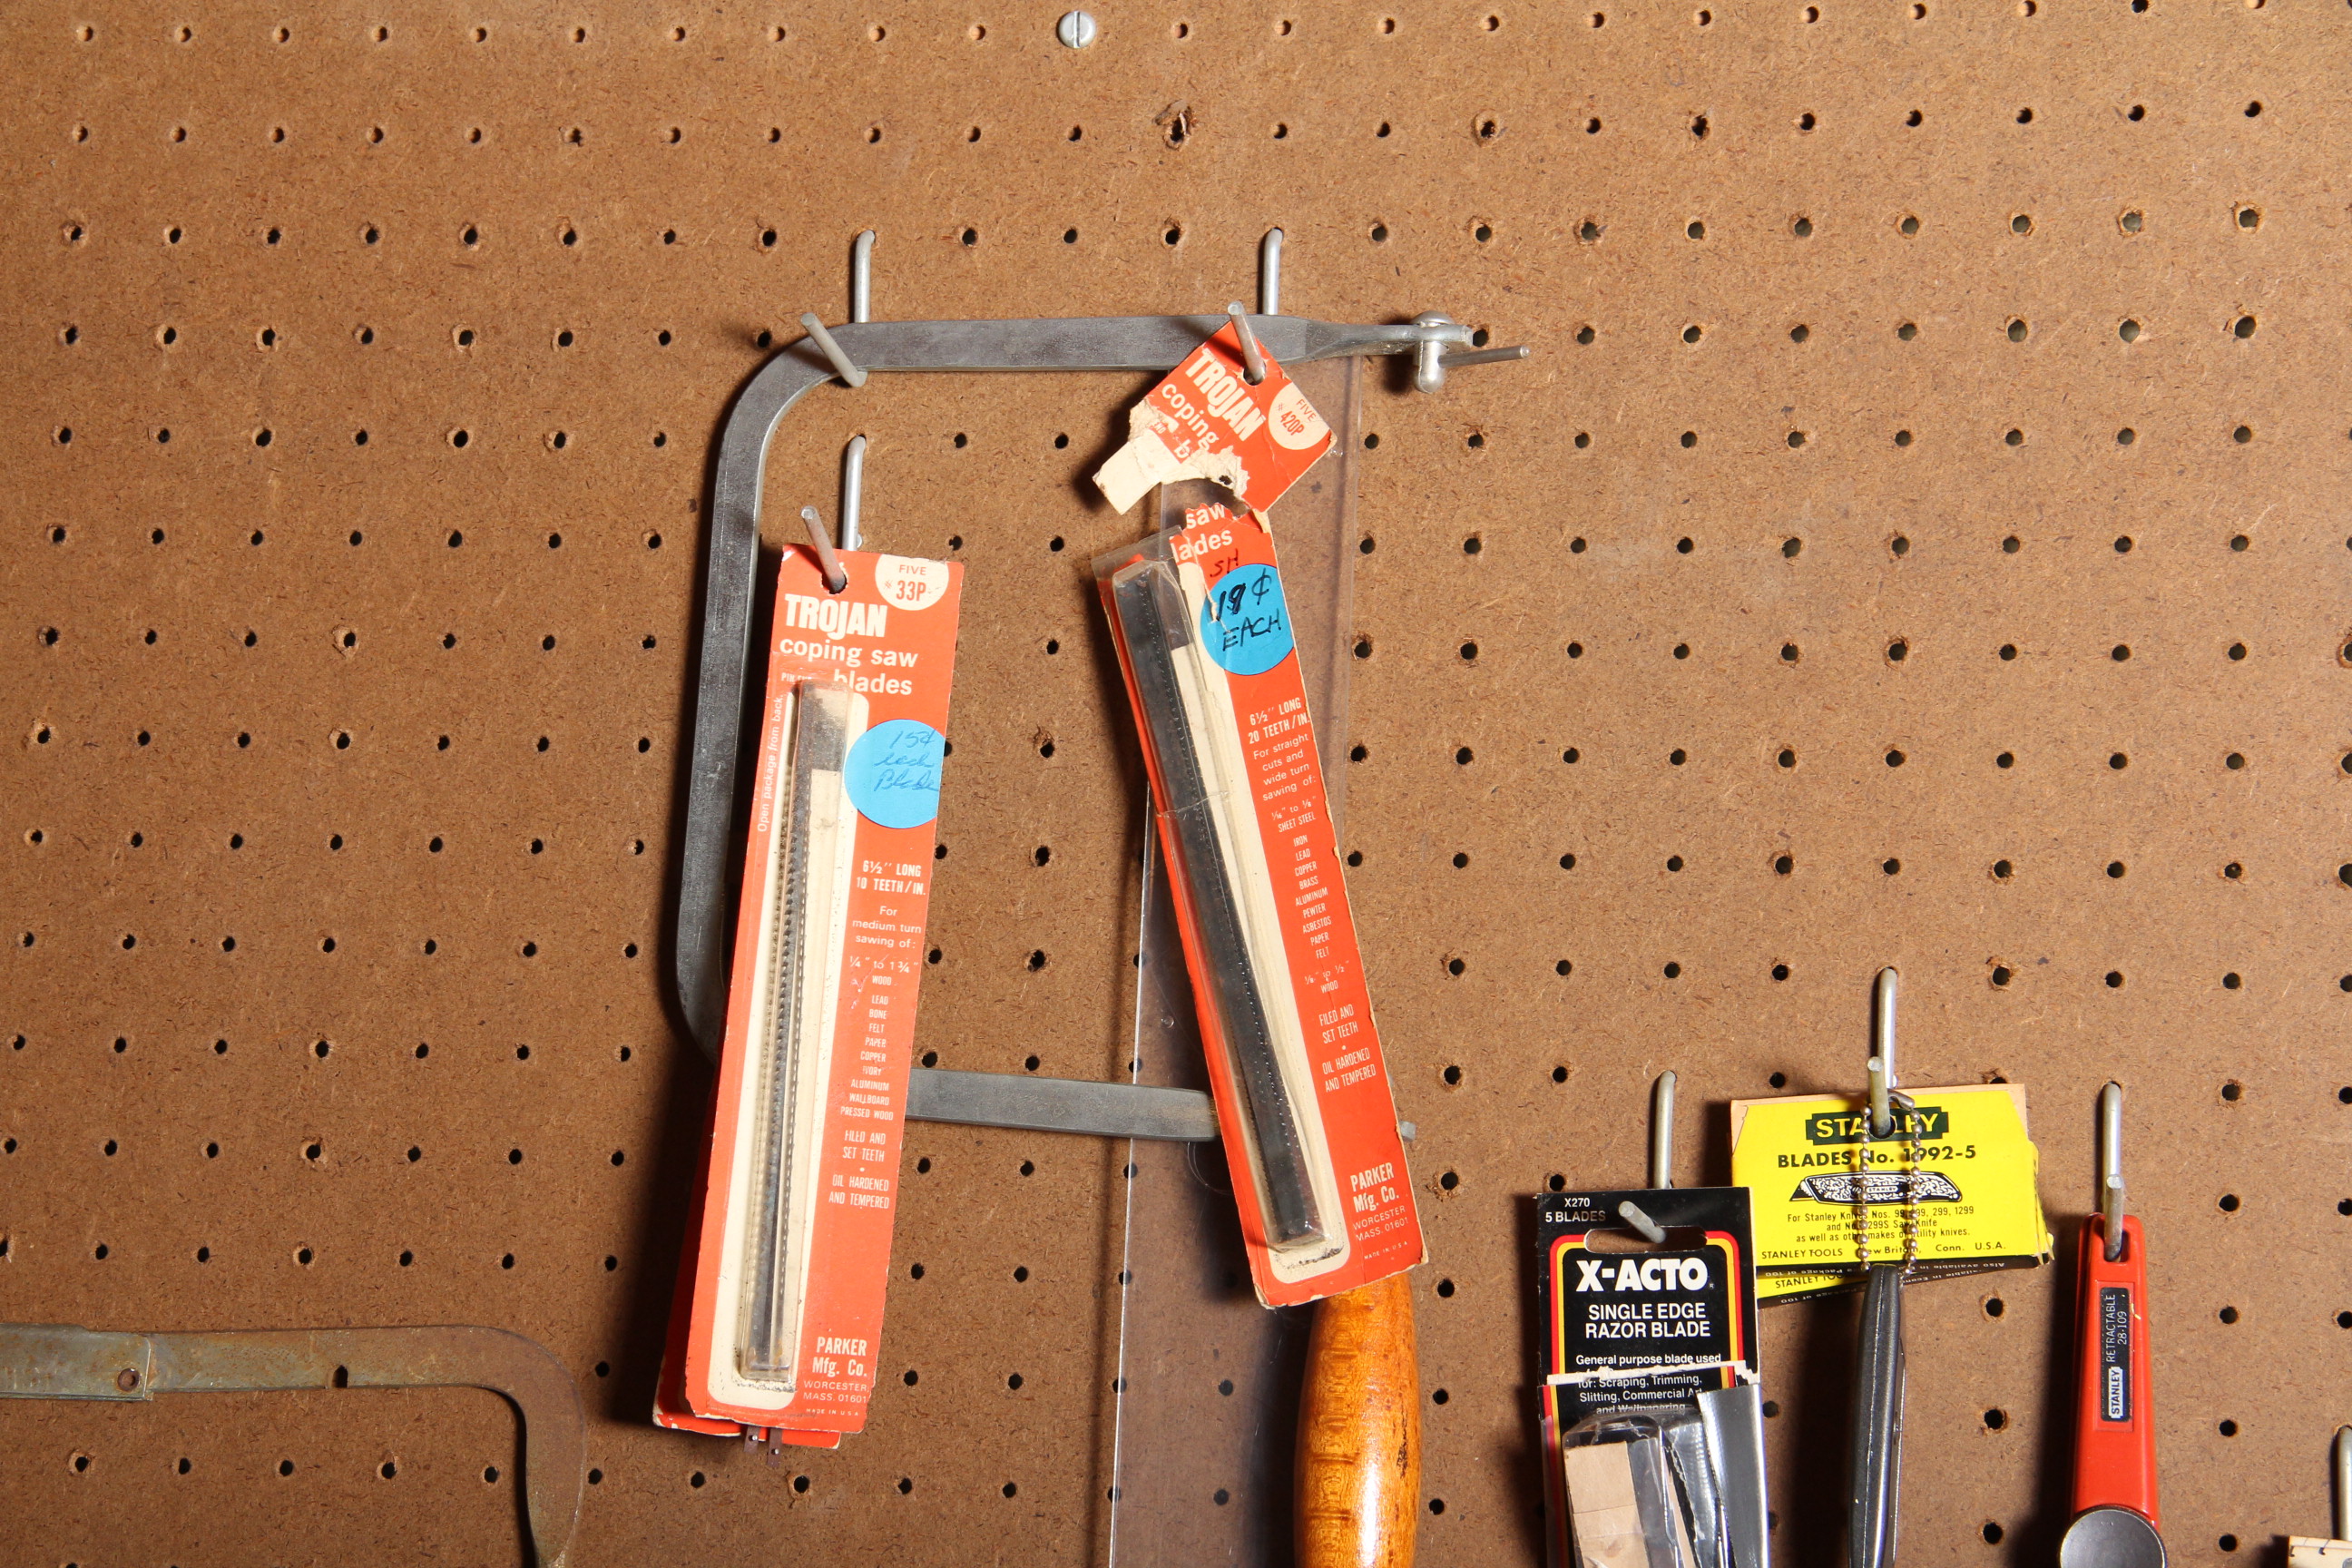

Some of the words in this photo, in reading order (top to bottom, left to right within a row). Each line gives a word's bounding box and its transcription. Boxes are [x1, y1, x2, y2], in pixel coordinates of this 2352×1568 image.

[1185, 348, 1267, 441] TROJAN
[1161, 383, 1220, 451] coping
[1296, 398, 1317, 422] FIVE
[1186, 505, 1225, 529] saw
[1171, 530, 1232, 563] lades
[899, 564, 926, 575] FIVE
[785, 593, 887, 640] TROJAN
[1222, 608, 1282, 652] EACH
[779, 639, 862, 667] coping
[870, 649, 918, 667] saw
[834, 669, 912, 695] blades
[771, 694, 784, 722] back.
[1279, 697, 1301, 715] LONG
[767, 726, 779, 751] from
[1249, 730, 1259, 744] 20
[1253, 749, 1269, 760] For
[1273, 733, 1308, 753] straight
[1263, 759, 1282, 771] cuts
[1287, 749, 1304, 762] and
[763, 754, 777, 799] package
[1263, 771, 1287, 785] wide
[1290, 763, 1309, 775] turn
[1263, 783, 1297, 800] sawing
[1303, 775, 1316, 786] of:
[758, 804, 769, 832] Open
[1278, 818, 1297, 832] SHEET
[1298, 811, 1316, 825] STEEL
[1293, 835, 1308, 847] IRON
[1296, 848, 1311, 861] LEAD
[896, 864, 922, 877] LONG
[1294, 861, 1318, 877] COPPER
[857, 877, 867, 889] 10
[1299, 876, 1318, 889] BRASS
[1296, 887, 1328, 906] ALUMINUM
[879, 906, 897, 916] For
[1303, 903, 1326, 918] PEWTER
[852, 920, 896, 932] medium
[900, 924, 922, 933] turn
[1302, 916, 1331, 934] ASBESTOS
[856, 935, 895, 948] sawing
[899, 938, 916, 948] of:
[1310, 932, 1329, 946] PAPER
[1316, 946, 1329, 958] FELT
[872, 975, 892, 986] WOOD
[1320, 980, 1338, 994] WOOD
[871, 995, 889, 1005] LEAD
[868, 1008, 887, 1019] BONE
[1318, 1010, 1338, 1026] FILED
[1340, 1004, 1354, 1019] AND
[868, 1023, 885, 1034] FELT
[1322, 1028, 1336, 1044] SET
[1337, 1021, 1358, 1038] TEETH
[865, 1037, 887, 1047] PAPER
[860, 1051, 886, 1063] COPPER
[1322, 1061, 1335, 1074] OIL
[1336, 1047, 1370, 1070] HARDENED
[862, 1065, 882, 1075] IVORY
[1325, 1077, 1339, 1093] AND
[1341, 1063, 1377, 1087] TEMPERED
[850, 1079, 889, 1092] ALUMINUM
[849, 1093, 890, 1106] WALLBOARD
[840, 1106, 870, 1118] PRESSED
[874, 1111, 894, 1121] WOOD
[1816, 1113, 1938, 1138] STALEY
[845, 1130, 866, 1142] FILED
[869, 1132, 886, 1145] AND
[842, 1146, 858, 1159] SET
[862, 1148, 886, 1162] TEETH
[1778, 1152, 1852, 1168] BLADES
[1904, 1145, 1976, 1161] 1992-5
[832, 1174, 844, 1187] OIL
[849, 1176, 889, 1192] HARDENED
[1350, 1162, 1394, 1192] PARKER
[828, 1191, 846, 1204] AND
[850, 1193, 889, 1209] TEMPERED
[1353, 1192, 1379, 1212] Mfg.
[1381, 1186, 1399, 1203] Co.
[1564, 1198, 1590, 1208] X270
[1545, 1211, 1553, 1223] 5
[1555, 1210, 1606, 1222] BLADES
[1788, 1214, 1800, 1222] For
[1805, 1212, 1837, 1222] Stanley
[1872, 1210, 1890, 1219] Nos.
[1955, 1206, 1975, 1214] 1299
[1356, 1227, 1383, 1241] MASS.
[1385, 1217, 1408, 1231] 01601
[1827, 1223, 1841, 1231] and
[1916, 1219, 1937, 1228] Knife
[1809, 1233, 1826, 1241] well
[1829, 1233, 1839, 1241] as
[1867, 1231, 1895, 1240] makes
[1940, 1228, 1970, 1237] knives.
[1761, 1250, 1807, 1259] STANLEY
[1809, 1249, 1843, 1257] TOOLS
[1936, 1244, 1965, 1252] Conn.
[1975, 1241, 2006, 1250] U.S.A.
[1575, 1258, 1708, 1292] X-ACTO
[1588, 1304, 1652, 1321] SINGLE
[1657, 1302, 1706, 1318] EDGE
[1585, 1322, 1647, 1338] RAZOR
[1651, 1320, 1710, 1338] BLADE
[2105, 1294, 2116, 1362] RETRACTABLE
[817, 1337, 867, 1357] PARKER
[812, 1357, 840, 1377] Mfg.
[848, 1359, 867, 1377] Co.
[1576, 1355, 1617, 1365] General
[1619, 1355, 1663, 1367] purpose
[1664, 1353, 1694, 1364] blade
[1696, 1353, 1721, 1363] used
[1599, 1377, 1650, 1389] Scraping,
[1651, 1374, 1702, 1387] Trimming,
[803, 1392, 835, 1402] MASS.
[838, 1395, 867, 1404] 01601
[1580, 1392, 1621, 1404] Slitting,
[1622, 1388, 1685, 1400] Commercial
[2111, 1370, 2120, 1415] STANLEY
